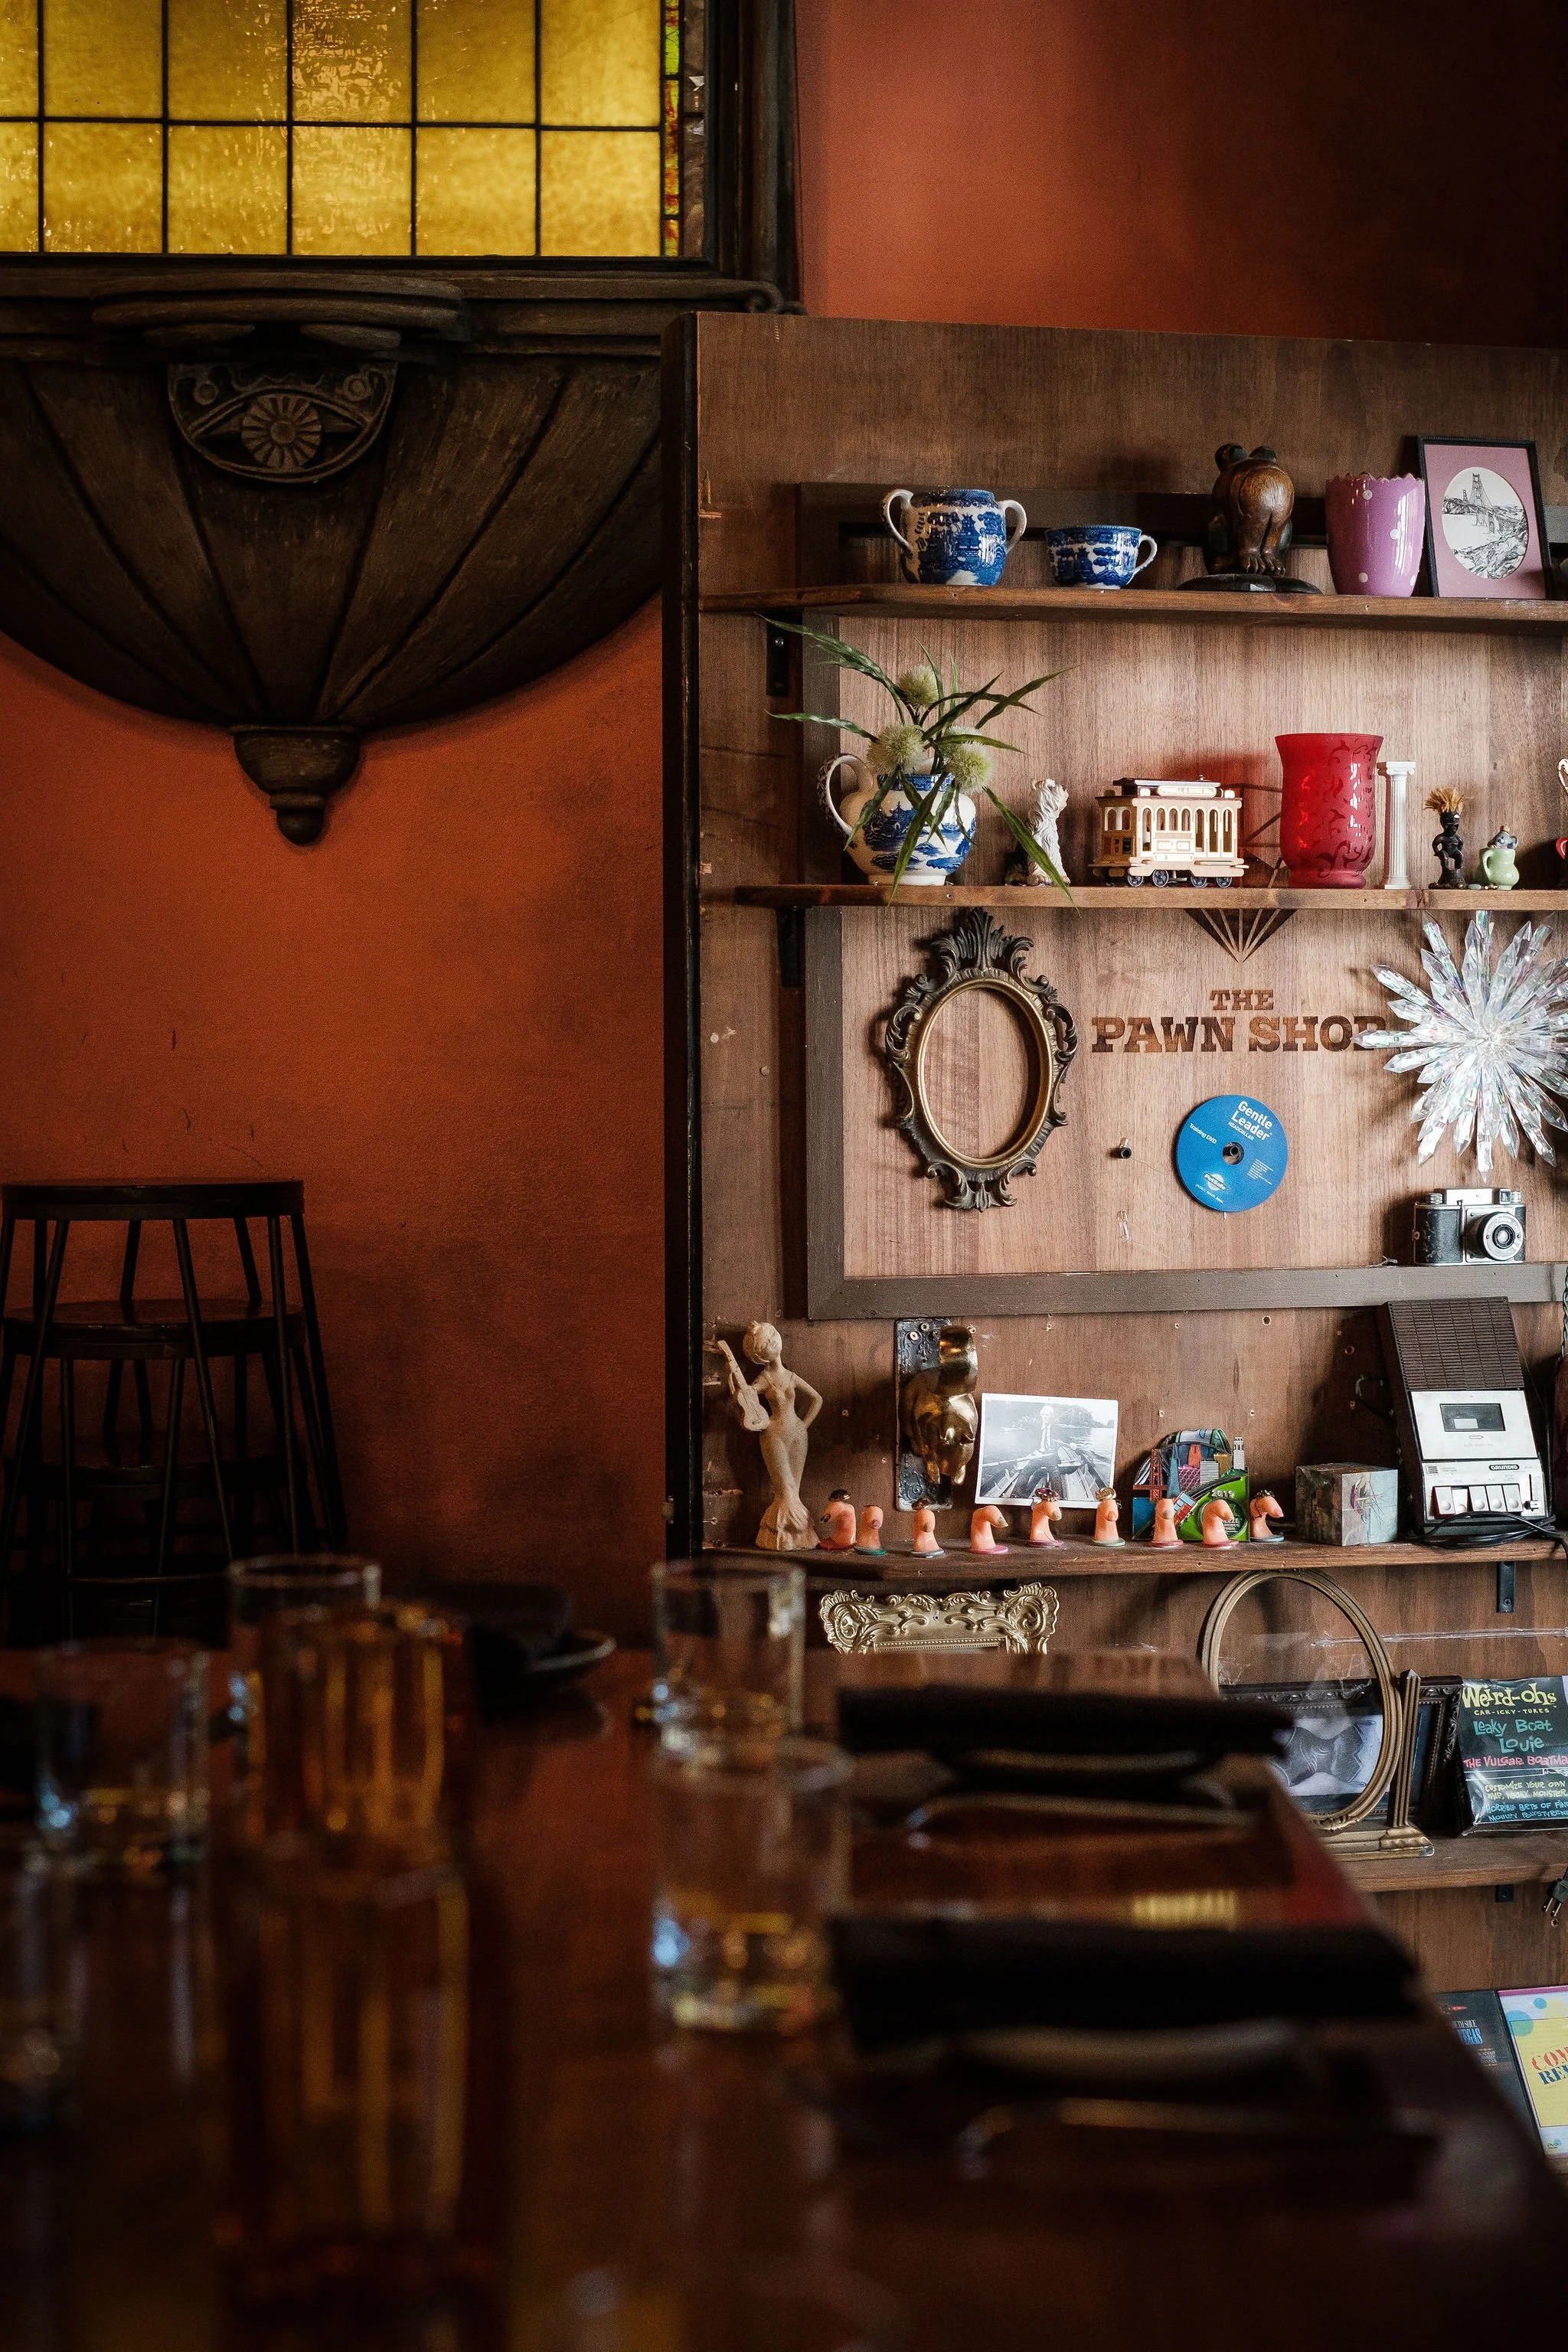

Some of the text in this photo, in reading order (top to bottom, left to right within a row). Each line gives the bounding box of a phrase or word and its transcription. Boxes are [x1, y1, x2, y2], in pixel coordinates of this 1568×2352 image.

[1210, 989, 1274, 1010] THE
[1092, 1016, 1236, 1053] PAWN
[1231, 1110, 1271, 1140] Leader
[1238, 1101, 1272, 1129] Gentle
[1190, 1122, 1217, 1144] Training DVD
[1211, 1490, 1234, 1498] 2019
[1462, 1683, 1557, 1708] Weird-ohs
[1473, 1719, 1553, 1736] Leaky Boat
[1499, 1735, 1544, 1753] Louie
[1464, 1759, 1481, 1768] THE
